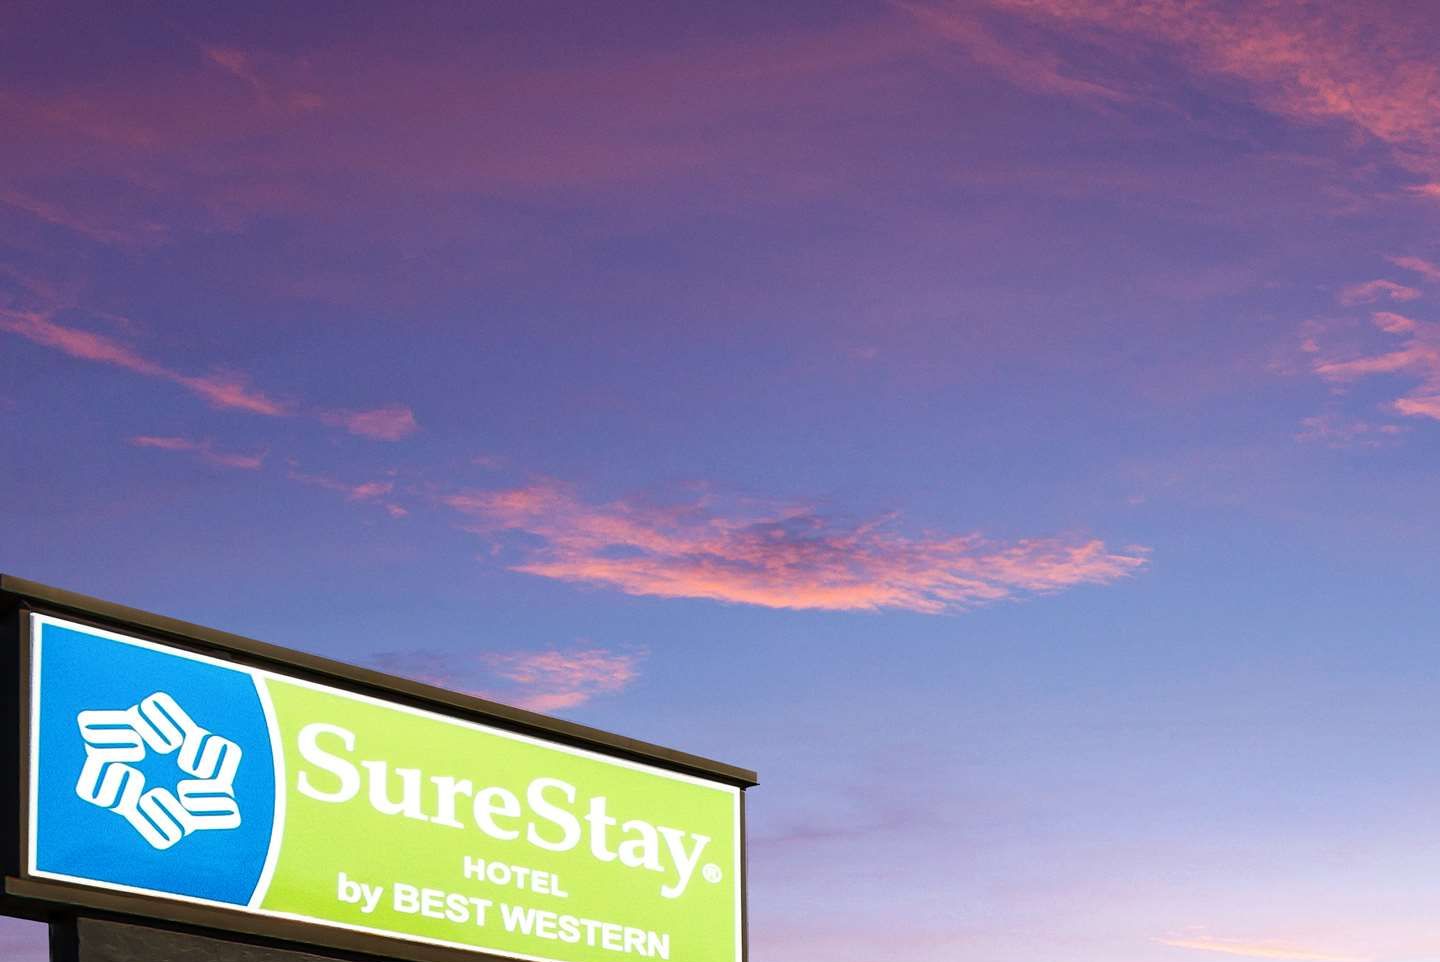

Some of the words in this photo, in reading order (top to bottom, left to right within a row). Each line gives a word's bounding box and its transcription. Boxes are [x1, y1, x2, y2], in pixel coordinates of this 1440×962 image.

[464, 855, 569, 897] HOTEL
[337, 872, 384, 914] by
[393, 882, 493, 927] BEST
[500, 902, 670, 960] WESTERN
